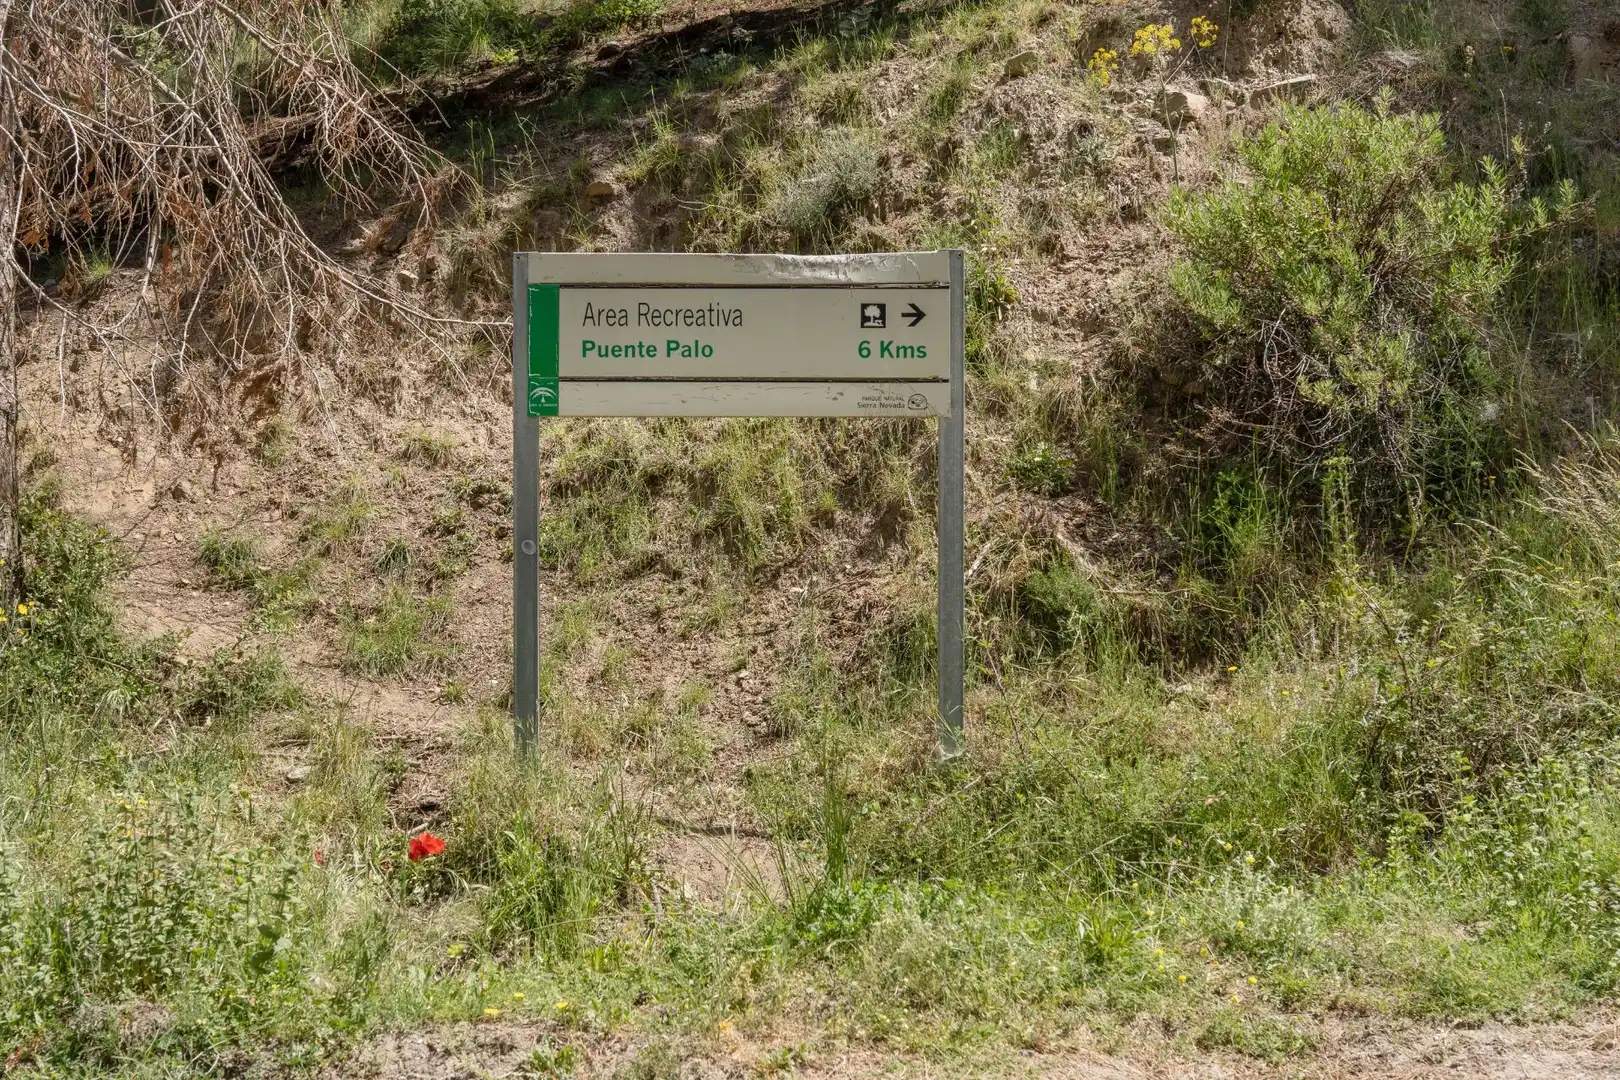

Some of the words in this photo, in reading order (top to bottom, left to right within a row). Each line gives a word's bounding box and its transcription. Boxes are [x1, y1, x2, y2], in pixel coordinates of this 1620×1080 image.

[582, 302, 629, 327] Area
[638, 302, 744, 327] Recreativa
[581, 340, 658, 358] Puente
[666, 340, 714, 358] Palo
[858, 340, 872, 358] 6
[880, 340, 928, 358] Kms
